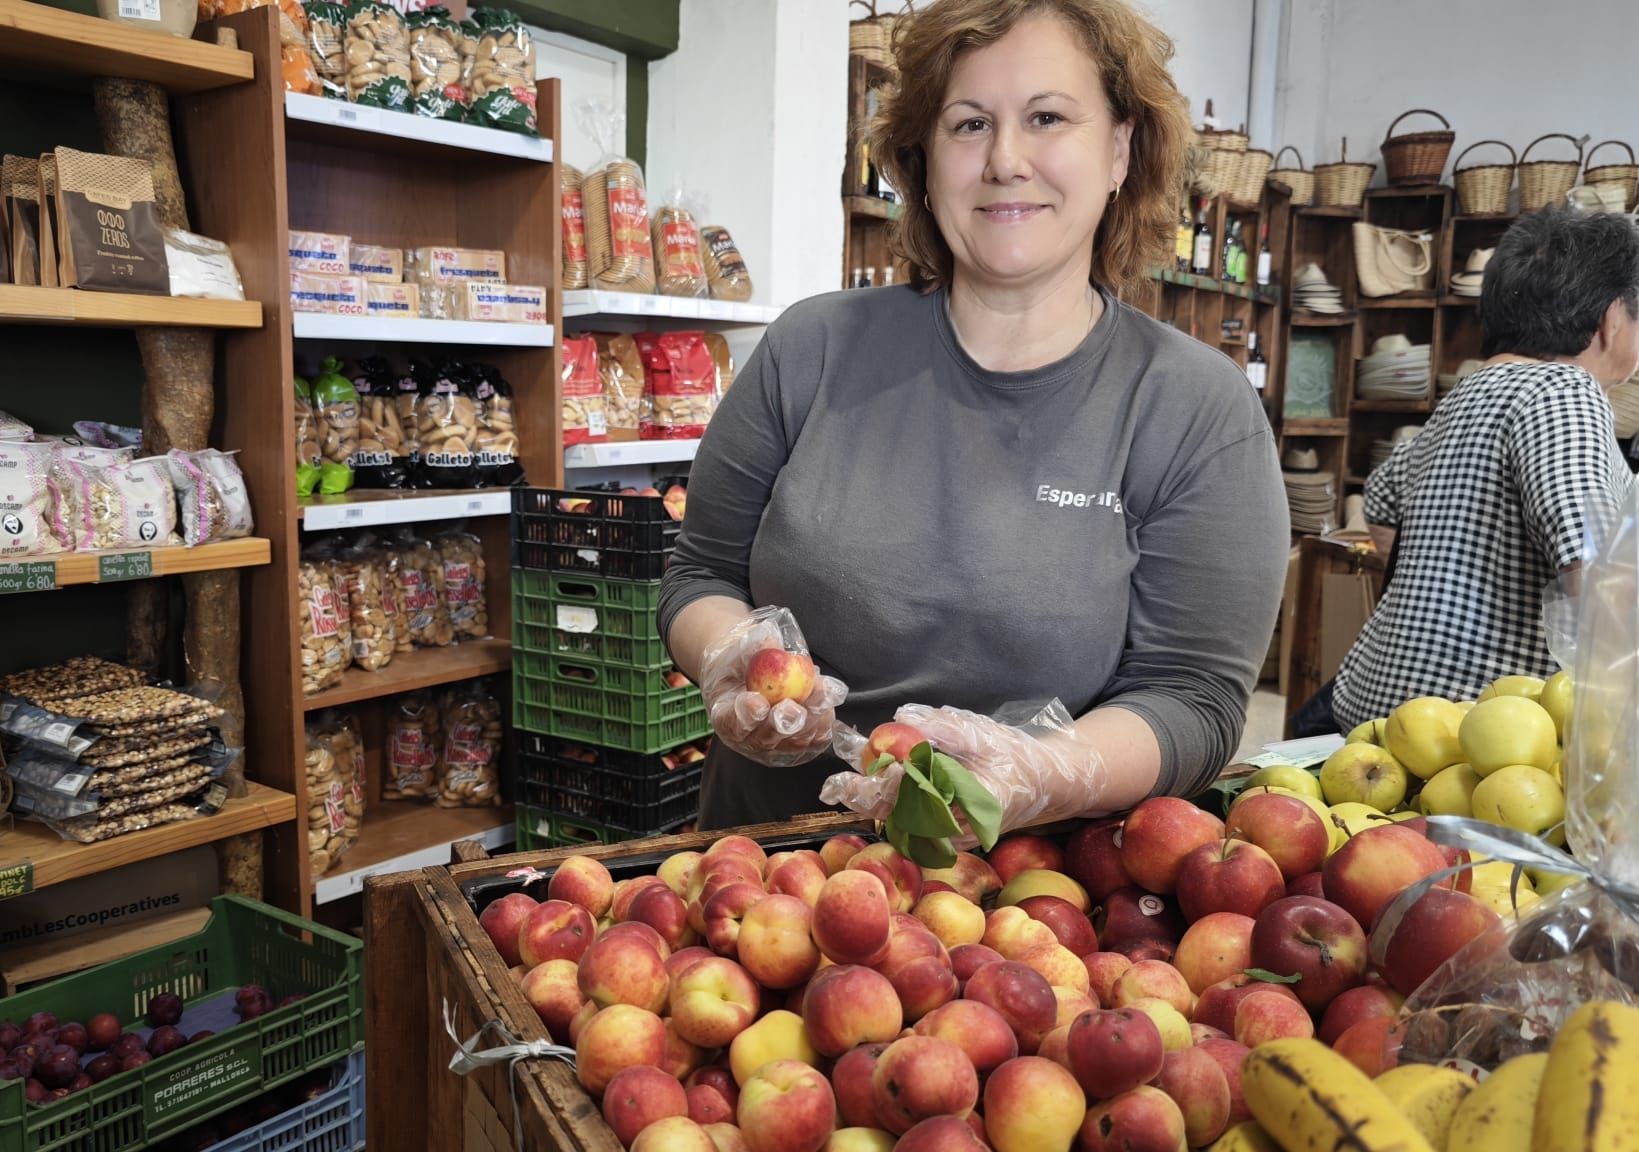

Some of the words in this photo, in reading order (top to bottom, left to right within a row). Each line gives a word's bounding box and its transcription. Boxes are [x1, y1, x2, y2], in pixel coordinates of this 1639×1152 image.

[100, 227, 130, 248] ZEROS
[0, 893, 180, 942] mbLesCooperatives
[154, 1064, 225, 1103] PORRERES
